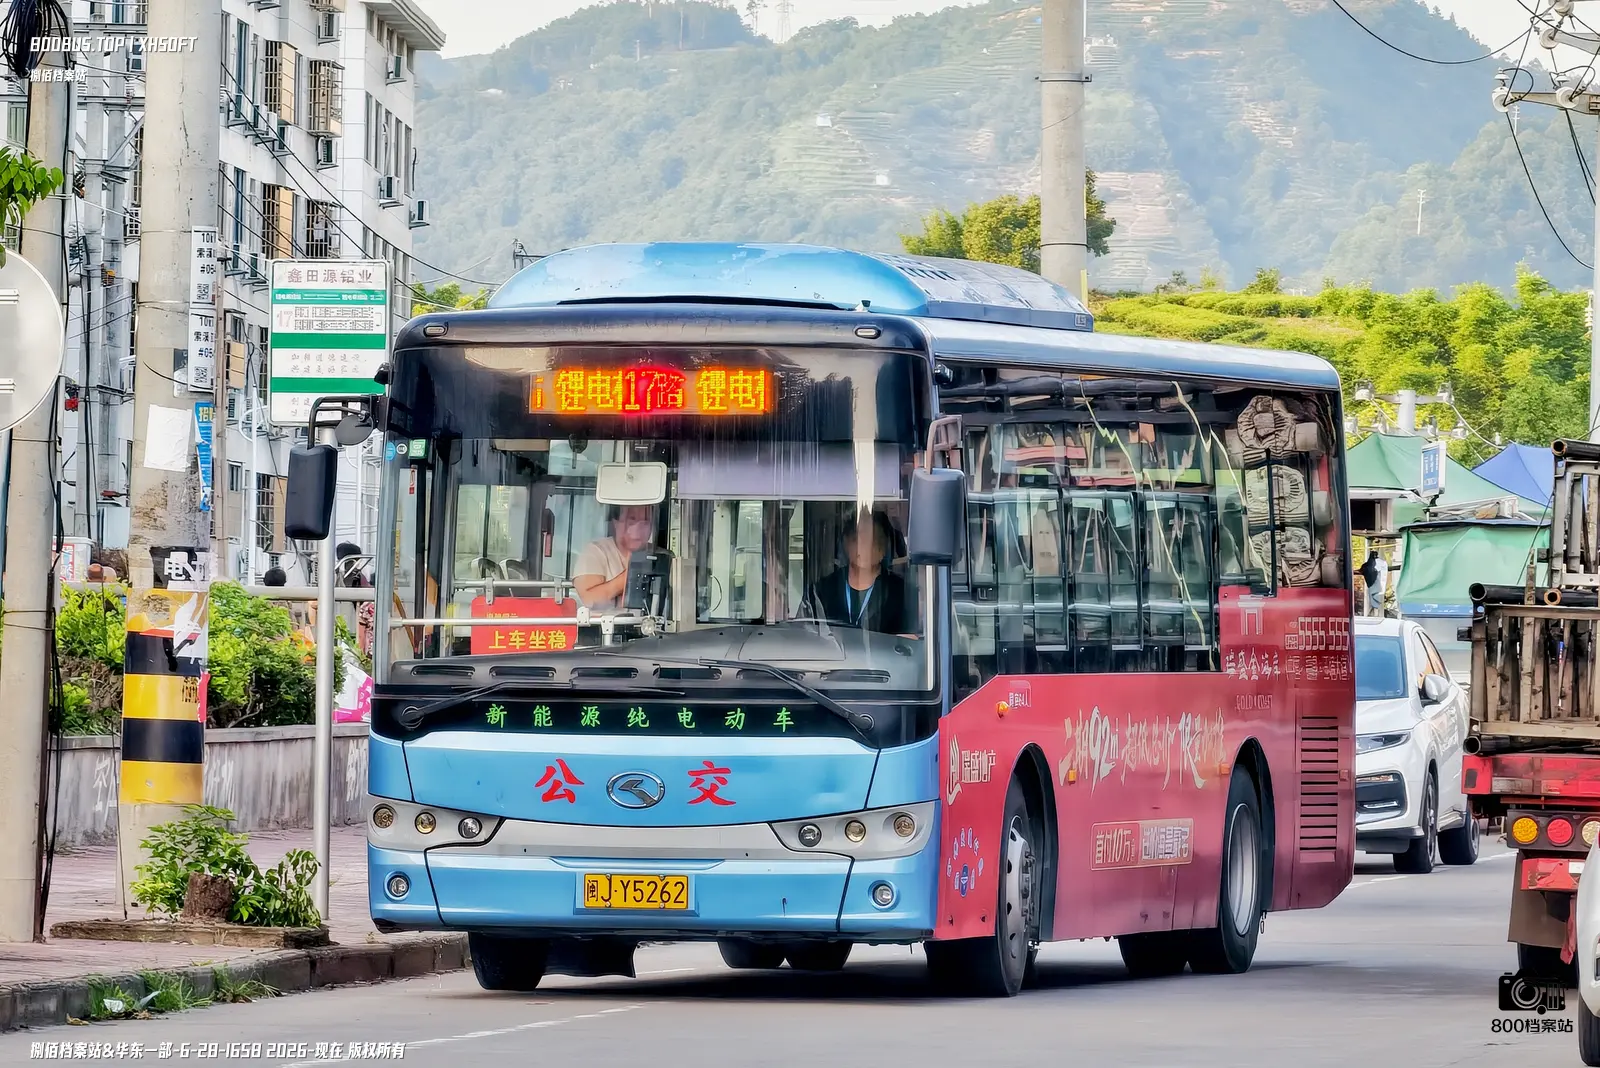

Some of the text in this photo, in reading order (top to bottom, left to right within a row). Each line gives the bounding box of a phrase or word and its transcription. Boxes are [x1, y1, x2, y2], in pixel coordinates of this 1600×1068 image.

[288, 268, 373, 284] 鑫田源铝业
[697, 370, 766, 411] 锂电
[488, 629, 567, 650] 上车坐稳
[485, 703, 795, 733] 新能源纯电动车
